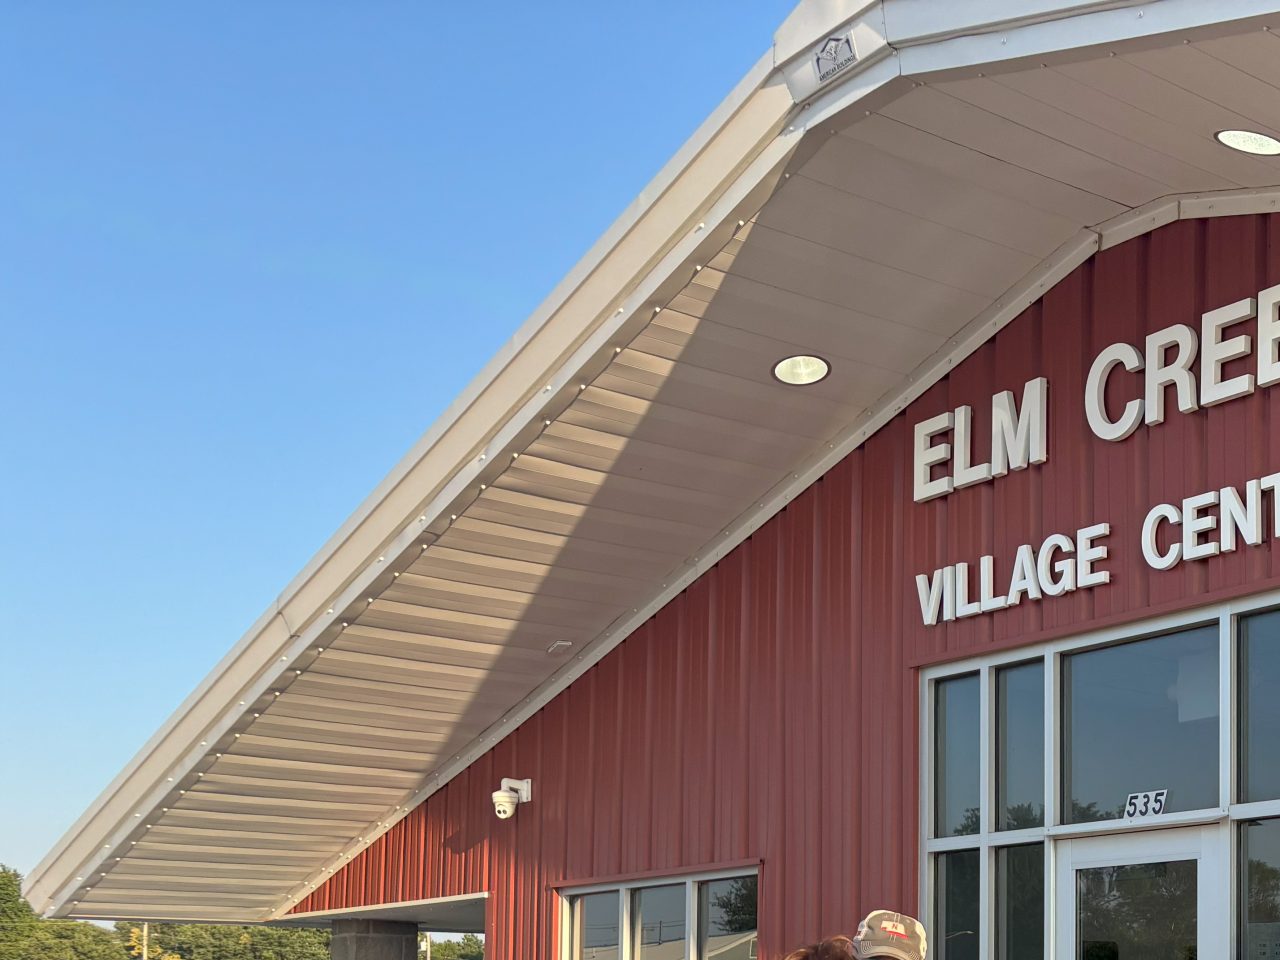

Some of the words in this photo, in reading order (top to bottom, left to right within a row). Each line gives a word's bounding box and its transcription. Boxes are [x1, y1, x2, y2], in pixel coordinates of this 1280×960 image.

[913, 377, 1049, 502] ELM
[915, 522, 1111, 626] VILLAGE
[1126, 791, 1165, 818] 535
